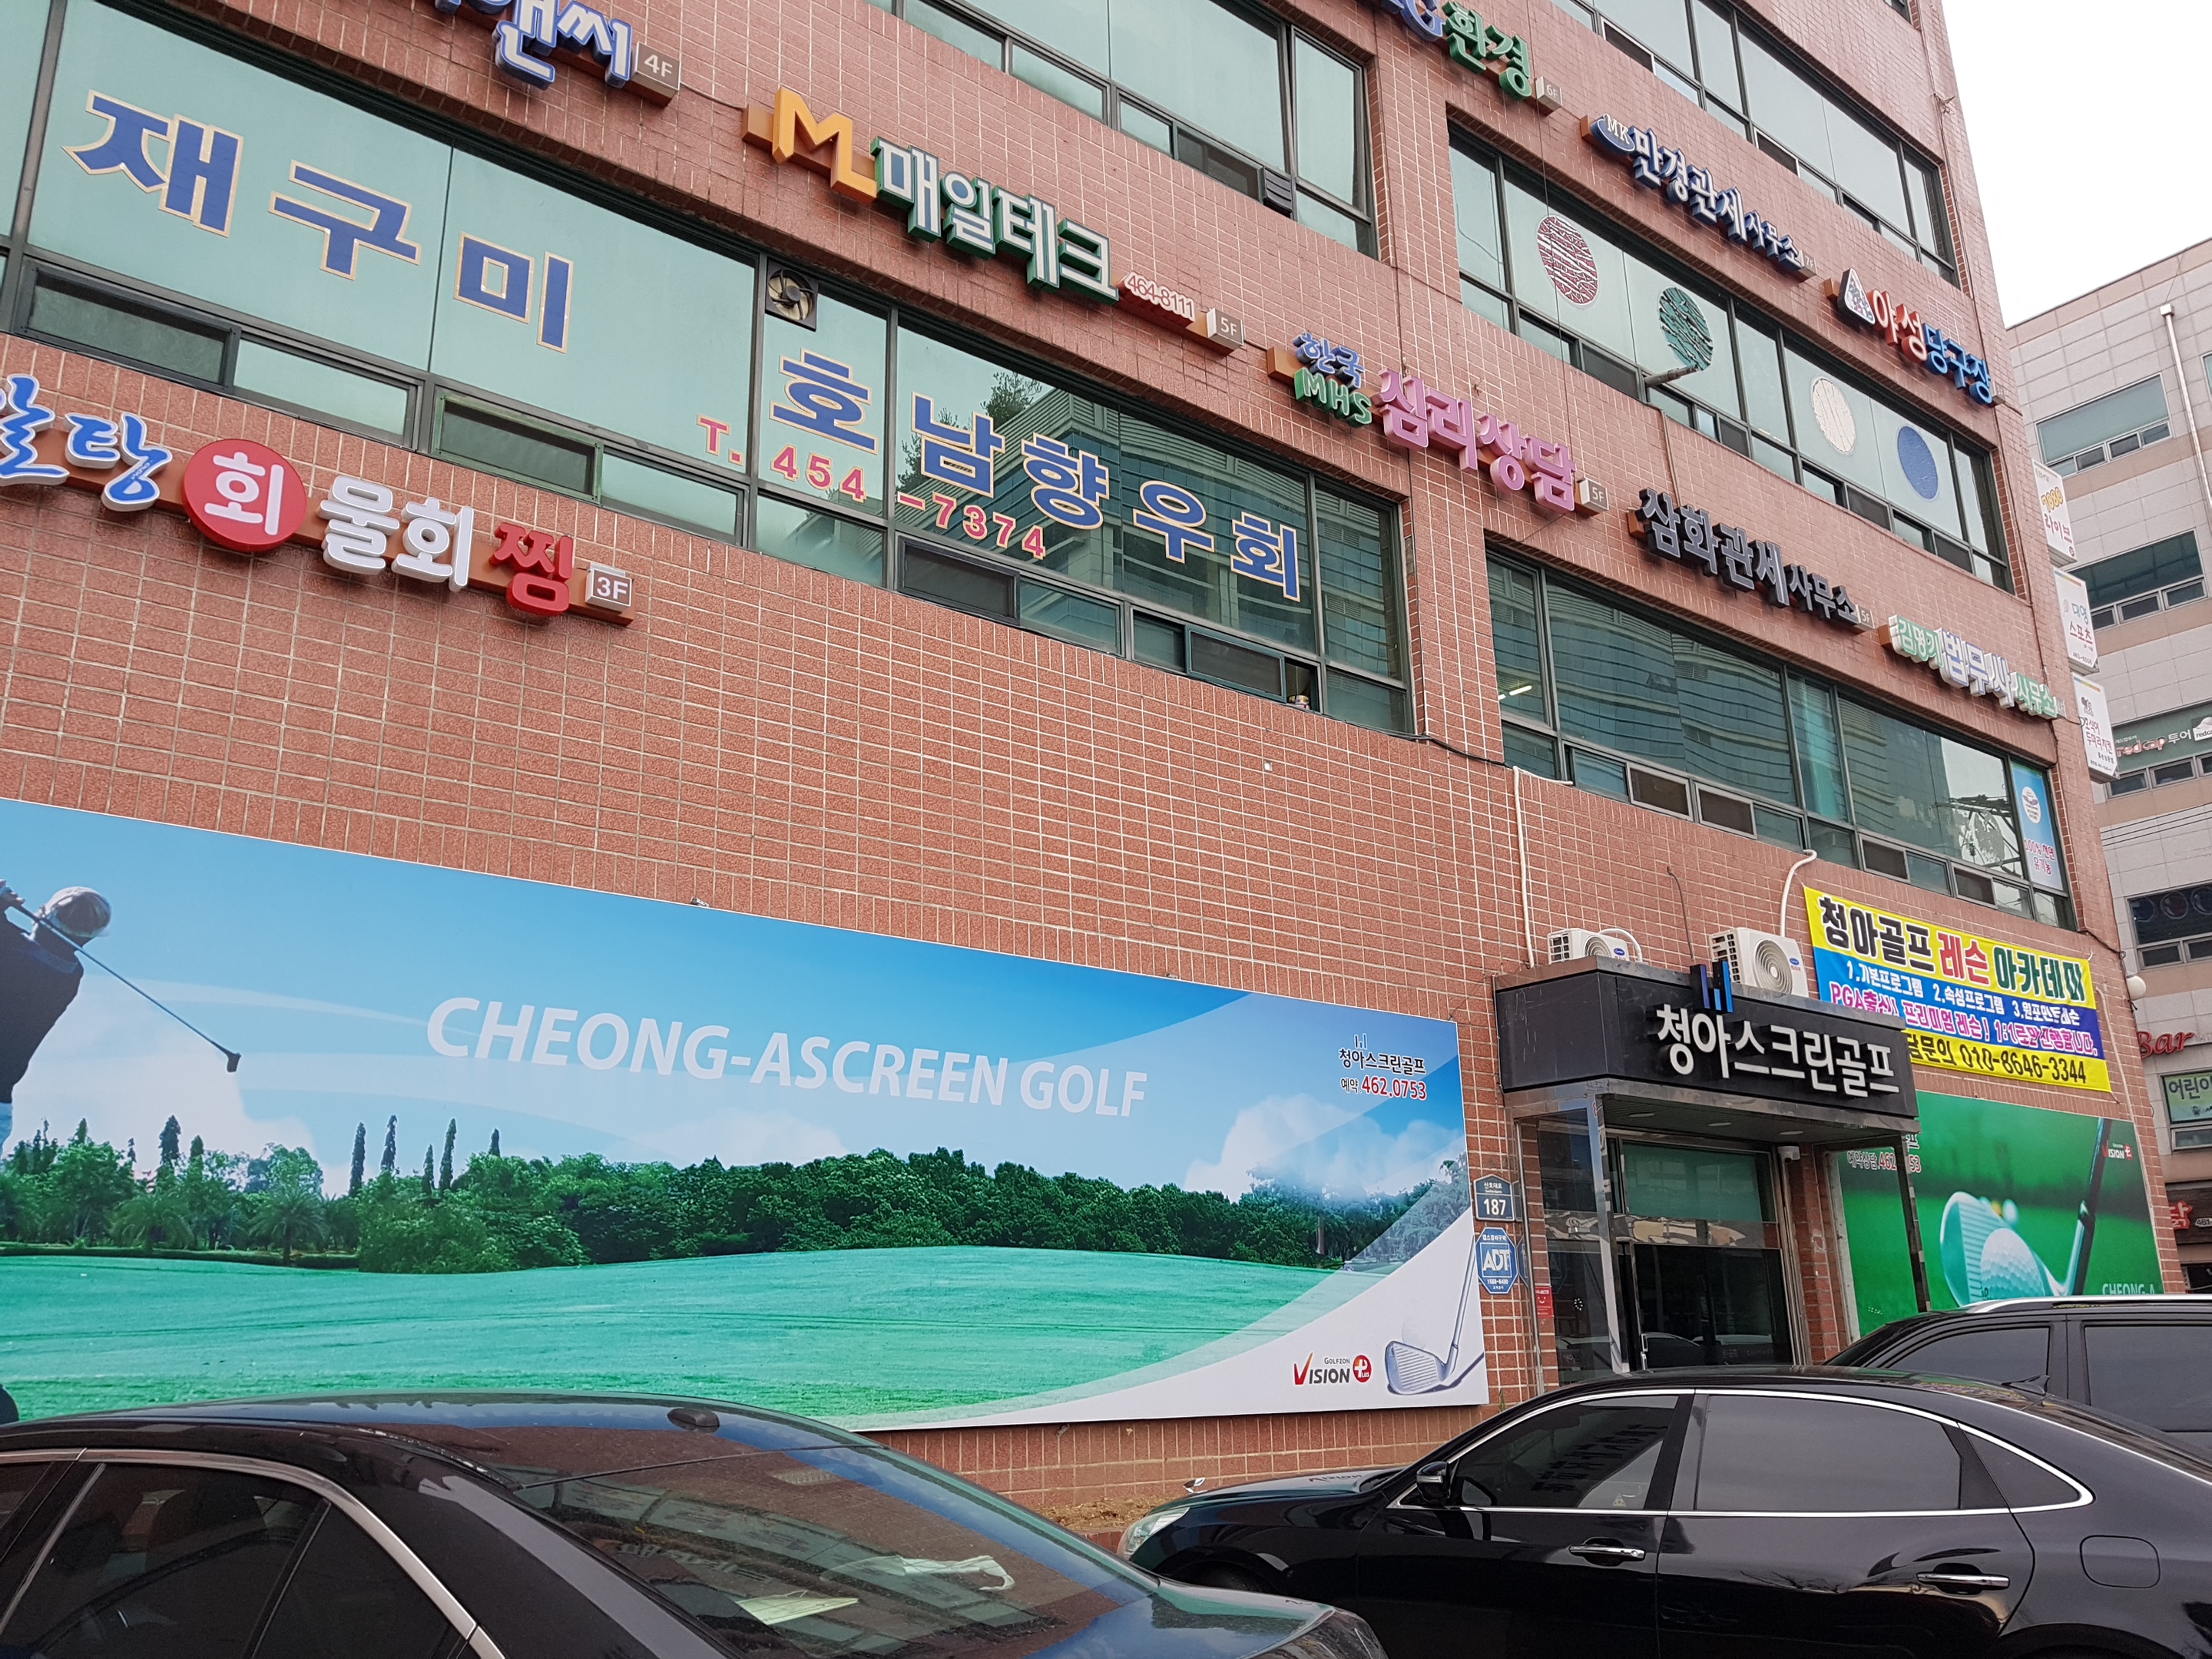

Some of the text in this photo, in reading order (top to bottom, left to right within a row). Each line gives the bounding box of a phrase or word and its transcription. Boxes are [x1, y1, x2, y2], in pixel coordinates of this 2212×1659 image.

[644, 54, 673, 78] 4F
[1442, 1, 1532, 101] 환경
[1546, 84, 1558, 98] 6F
[1603, 114, 1630, 144] MK
[773, 86, 1237, 336] ML 매일테크 464-8111 5F
[62, 90, 1301, 602] 재구미 호남향우회
[1293, 330, 1365, 388] 한국
[1922, 323, 1993, 405] 당구장
[1294, 366, 1373, 428] MHS
[1372, 366, 1604, 513] 심리상담 5F
[2041, 486, 2063, 513] 7080
[320, 475, 474, 591] 물회
[595, 575, 629, 601] 3F
[2044, 513, 2072, 543] 라이브
[1860, 610, 1871, 623] 5F
[2070, 621, 2093, 644] 스포츠
[1940, 629, 2015, 707] 법무사
[2015, 673, 2057, 716] 사무소
[2086, 731, 2113, 755] 두마리치킨
[2116, 737, 2167, 757] redcap
[2168, 729, 2192, 743] 투어
[2033, 856, 2051, 876] 유기농
[1819, 896, 2086, 1002] 청아골프 레슨 아카데미
[1902, 1000, 1957, 1035] 프리미엄
[1655, 1003, 1900, 1098] 청아스크린골프
[2137, 1030, 2194, 1058] Bar
[1339, 1048, 1426, 1075] 청아스크린골프
[1959, 1044, 2087, 1084] 010-8646-3344
[1021, 1060, 1148, 1118] GOLF
[1483, 1198, 1506, 1216] 187
[1482, 1248, 1511, 1271] ADT
[1293, 1352, 1350, 1386] VISION
[1323, 1356, 1350, 1365] GOLFZON
